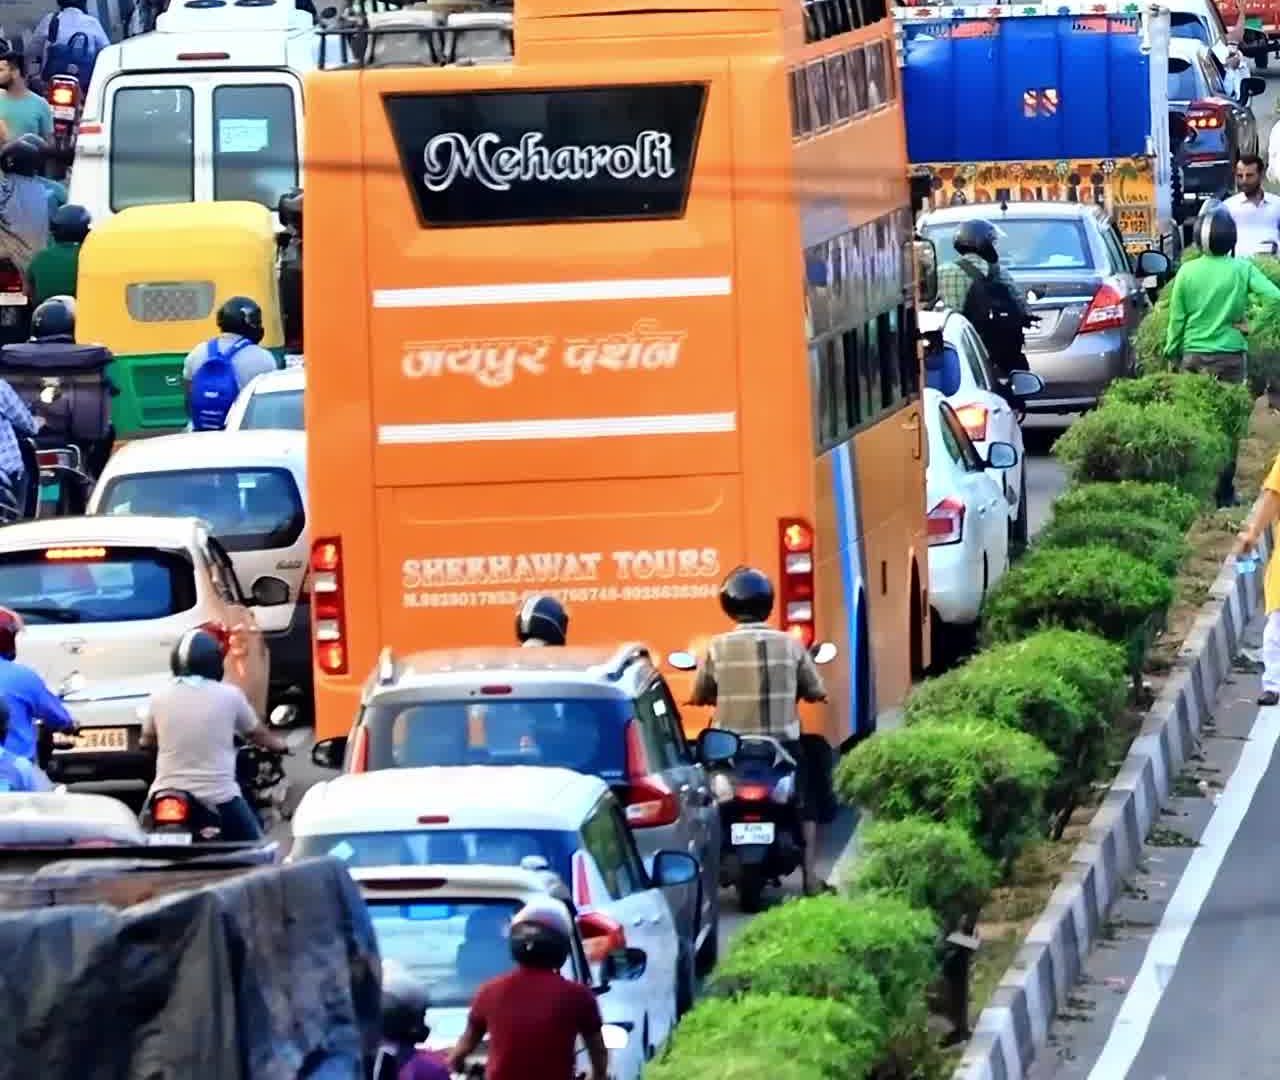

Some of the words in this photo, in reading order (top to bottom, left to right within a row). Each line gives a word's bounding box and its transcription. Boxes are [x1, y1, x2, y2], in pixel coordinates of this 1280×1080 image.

[424, 130, 674, 192] Meharoli
[402, 334, 556, 388] जयपुर
[562, 317, 688, 375] दर्शन
[402, 550, 603, 589] SHEKHAWAT
[612, 546, 721, 580] TOURS
